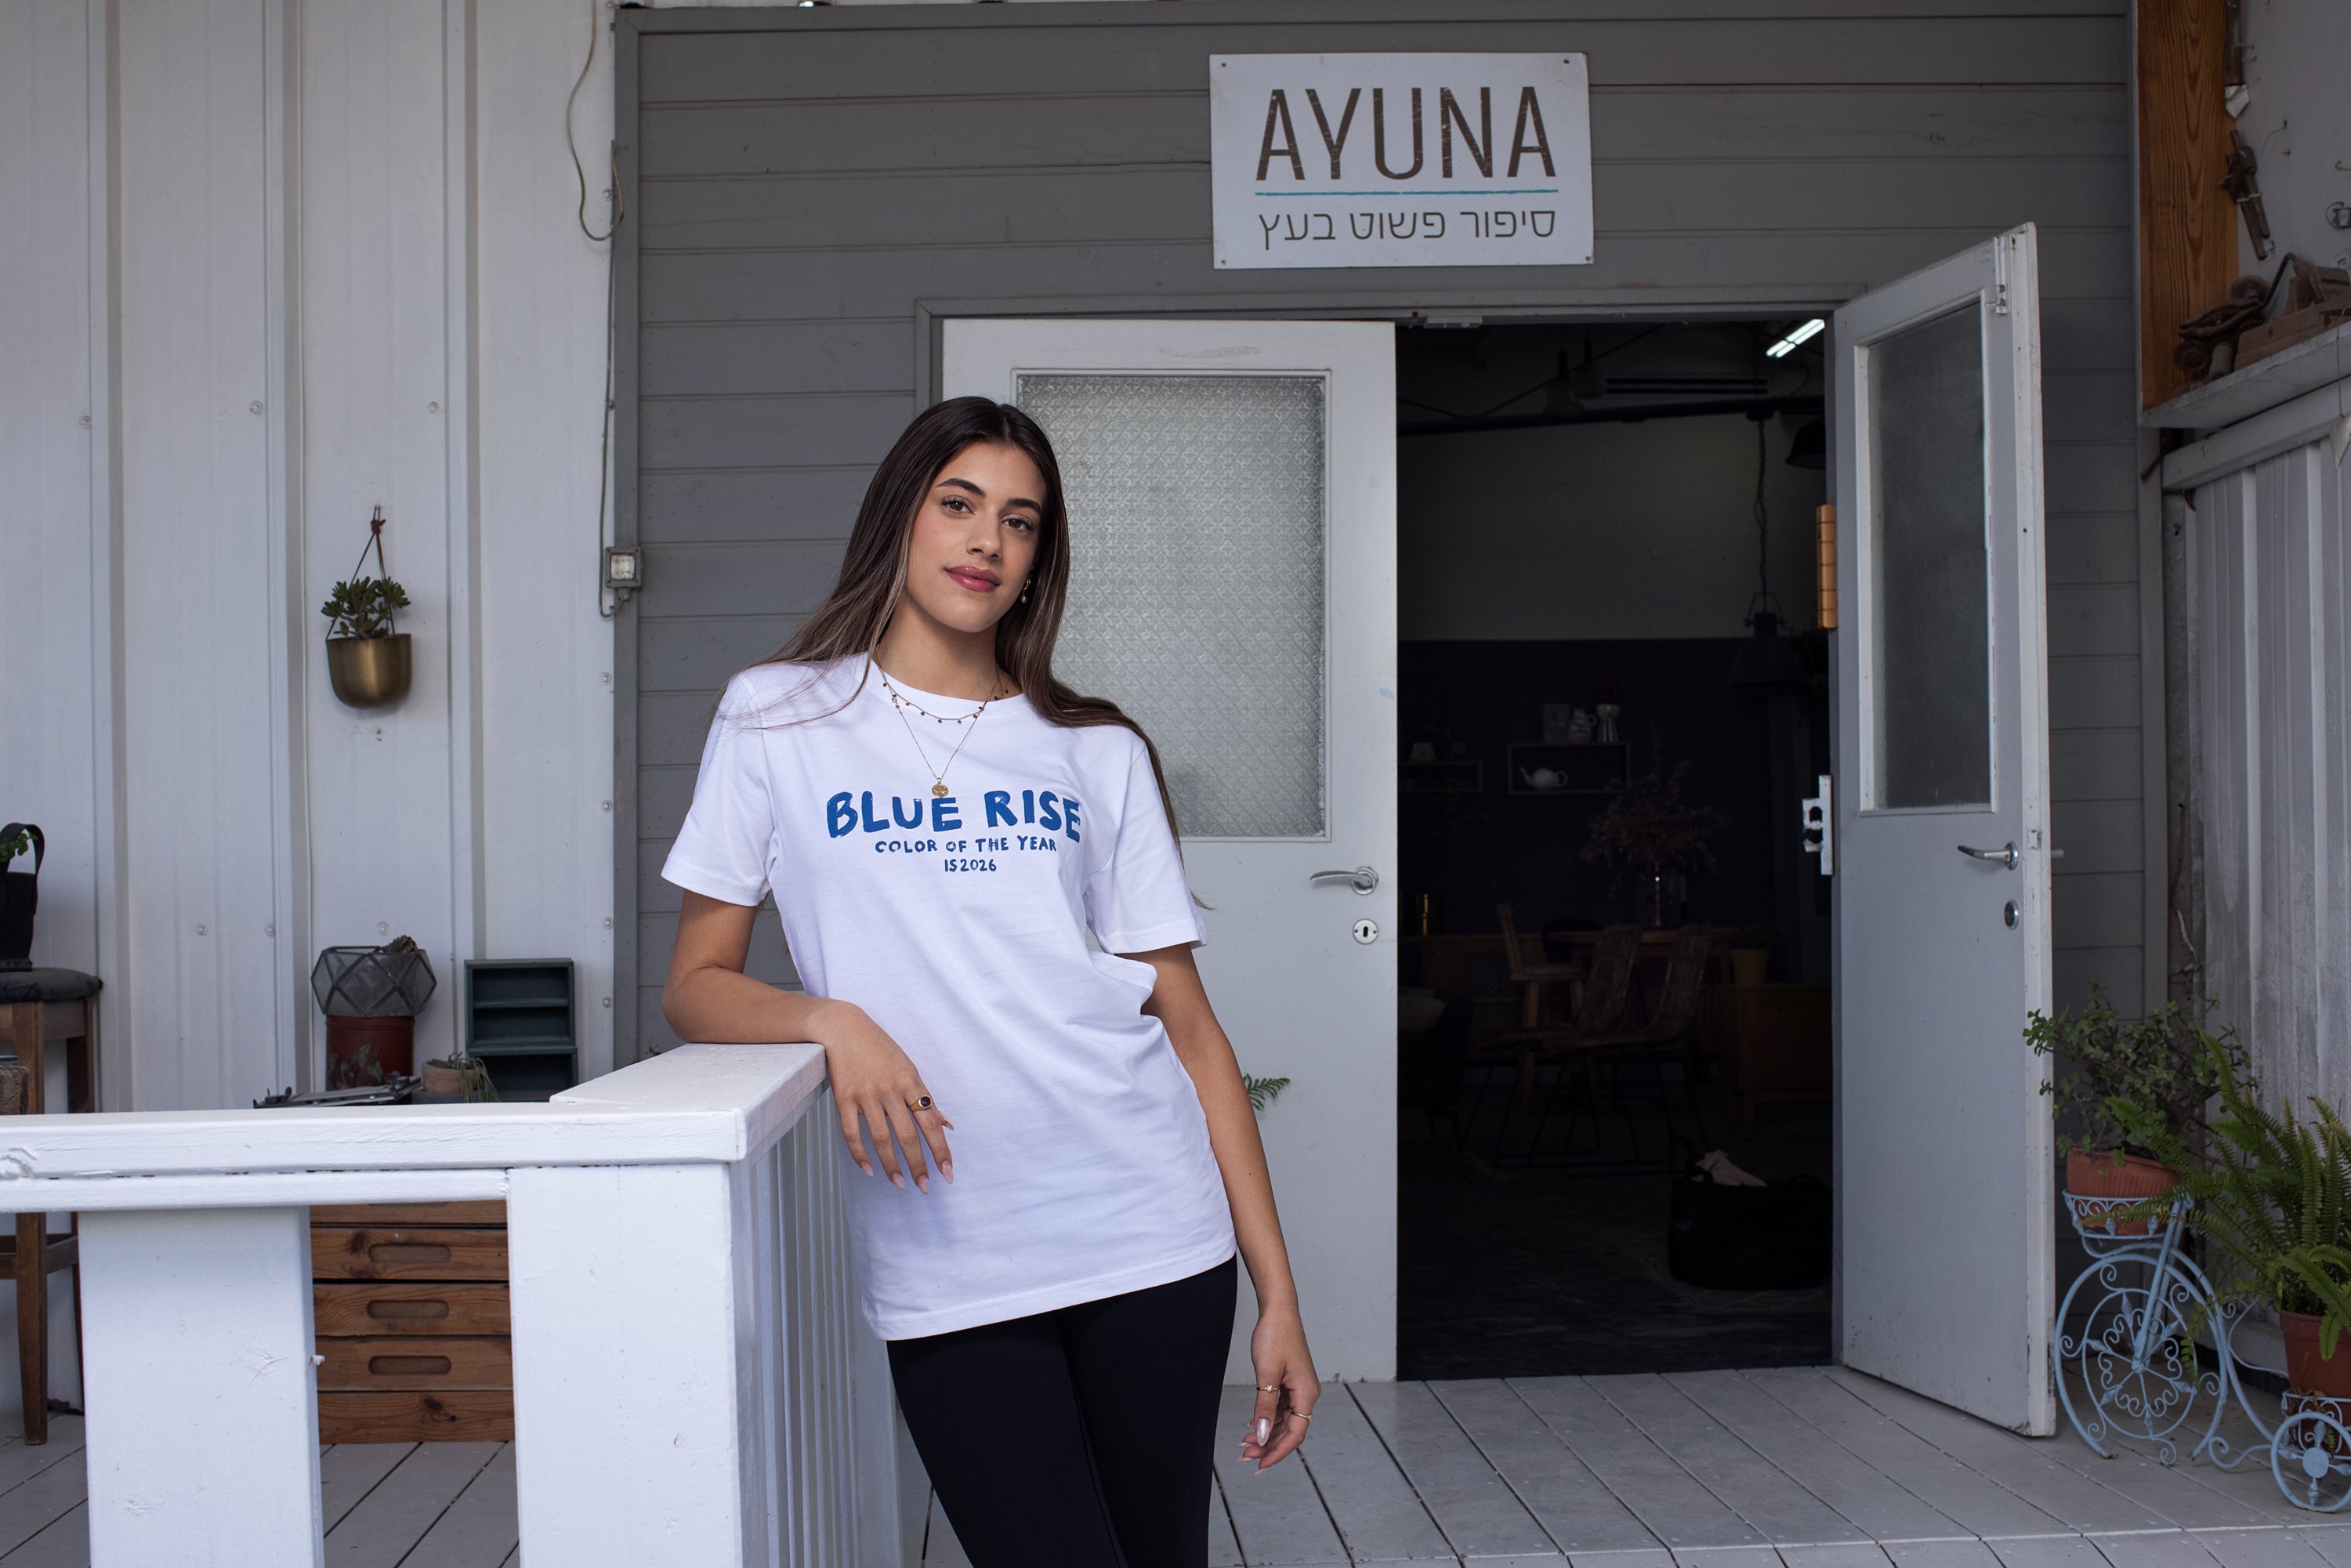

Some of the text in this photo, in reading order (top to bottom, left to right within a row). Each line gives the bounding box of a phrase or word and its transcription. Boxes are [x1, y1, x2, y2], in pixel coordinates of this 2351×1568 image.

[1255, 85, 1556, 181] AYUNA
[1258, 210, 1556, 251] סיפור פשוט בעץ
[826, 789, 1081, 843] BLUE RISE
[875, 835, 1057, 853] COLOR OF THE YEAR
